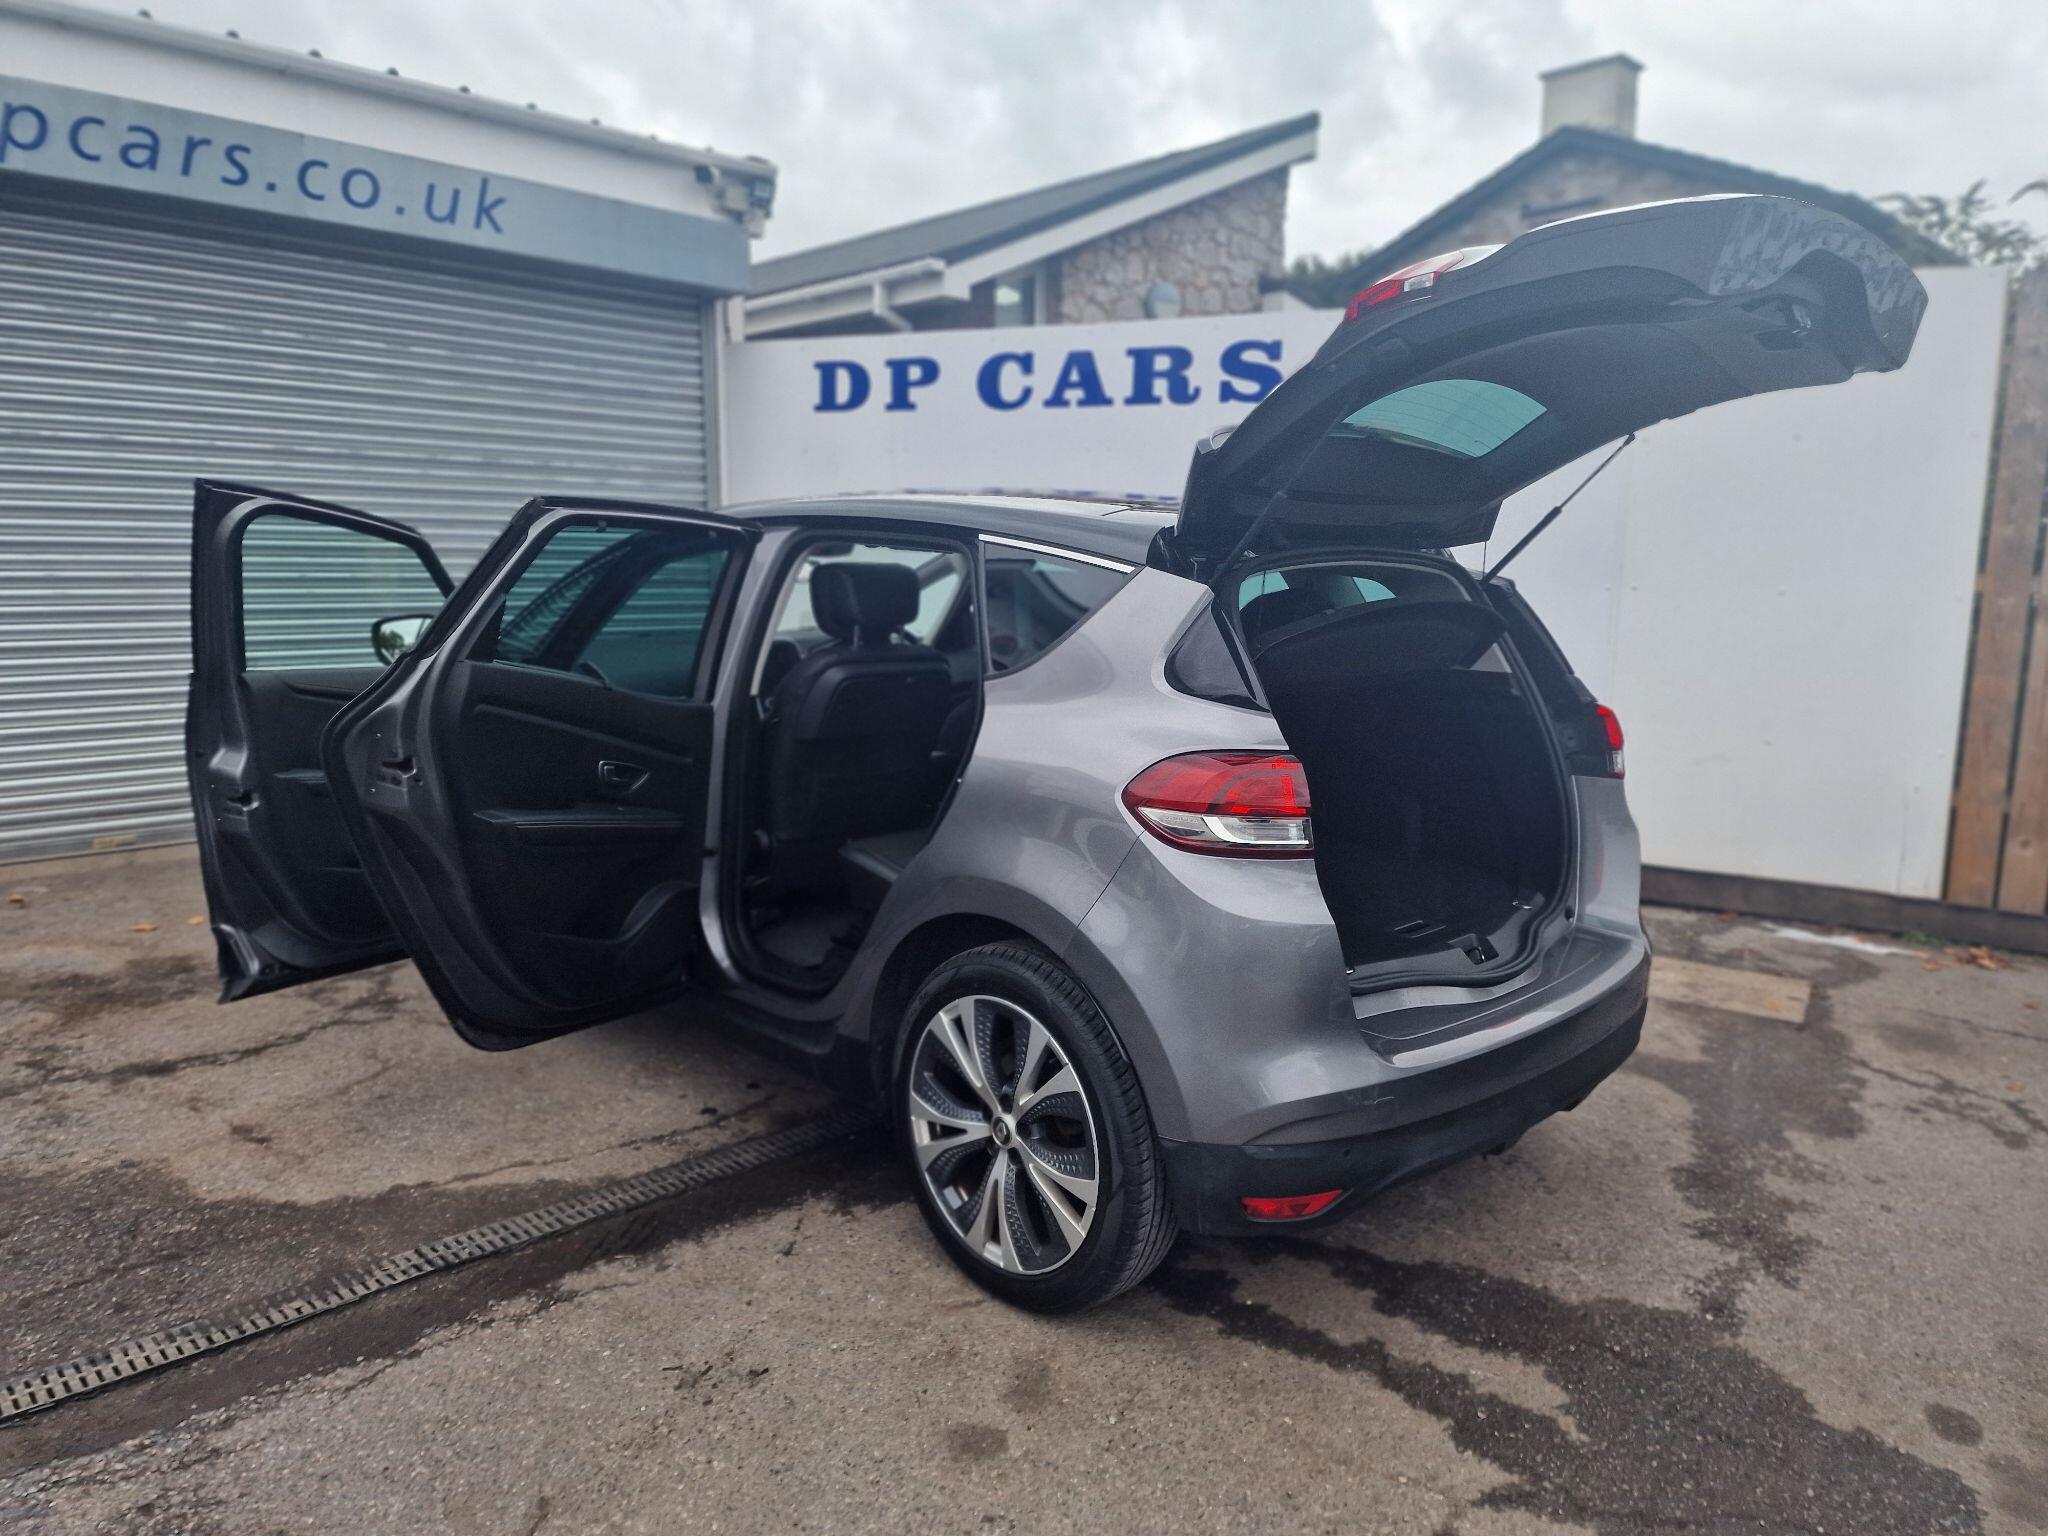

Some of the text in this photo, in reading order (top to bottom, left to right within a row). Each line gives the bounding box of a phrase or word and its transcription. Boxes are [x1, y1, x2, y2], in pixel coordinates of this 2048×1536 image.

[0, 102, 507, 234] pcars.co.uk
[813, 340, 1284, 412] DP CARS
